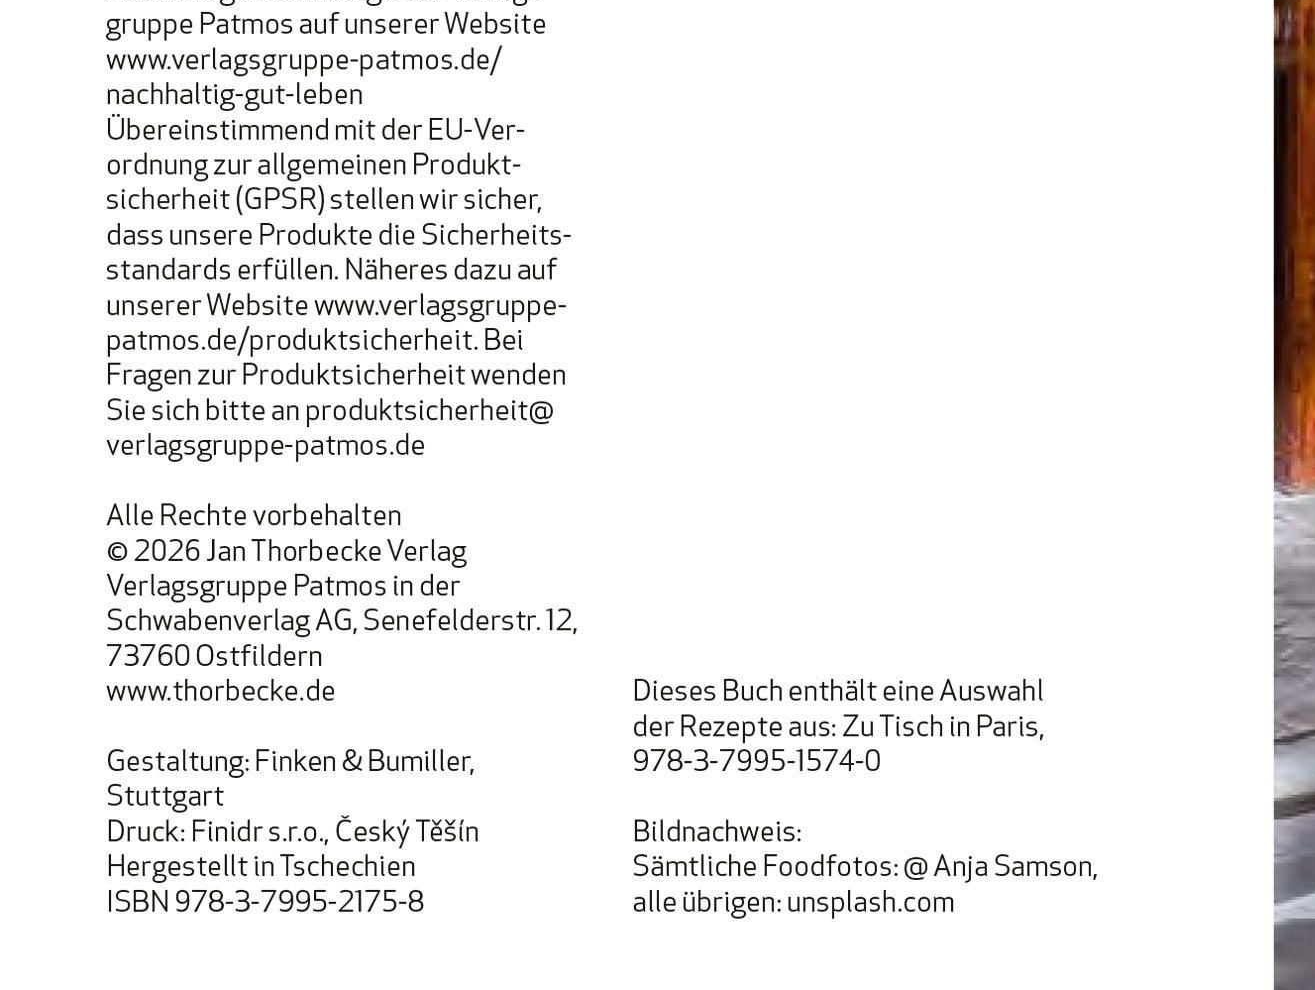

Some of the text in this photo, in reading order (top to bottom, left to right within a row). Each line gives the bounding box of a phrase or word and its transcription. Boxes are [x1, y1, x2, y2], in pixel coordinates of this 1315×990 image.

[106, 44, 503, 78] www.verlagsgruppe-patmos.de/
[107, 81, 363, 112] nachhaltig-gut-leben
[107, 113, 525, 141] Übereinstimmend mit der EU-Ver-
[107, 151, 522, 183] ordnung zur allgemeinen Produkt-
[106, 184, 542, 216] sicherheit (GPSR) stellen wir sicher,
[107, 292, 567, 323] unserer Website www.verlagsgruppe-
[107, 325, 523, 358] patmos.de/produktsicherheit. Bei
[107, 362, 566, 393] Fragen zur Produktsicherheit wenden
[107, 397, 554, 428] Sie sich bitte an produktsicherheit@
[106, 432, 425, 463] verlagsgruppe-patmos.de
[106, 502, 401, 526] Alle Rechte vorbehalten
[107, 538, 468, 569] © 2026 Jan Thorbecke Verlag
[106, 573, 461, 604] Verlagsgruppe Patmos in der
[107, 607, 578, 638] Schwabenverlag AG, Senefelderstr. 12,
[106, 643, 322, 667] 73760 Ostfildern
[105, 678, 335, 702] www.thorbecke.de
[634, 678, 1044, 702] Dieses Buch enthält eine Auswahl
[633, 713, 1044, 744] der Rezepte aus: Zu Tisch in Paris,
[107, 748, 475, 779] Gestaltung: Finken & Bumiller,
[633, 748, 881, 772] 978-3-7995-1574-0
[107, 783, 225, 814] Stuttgart
[108, 814, 479, 849] Druck: Finidr s.r.o., Český Těšín
[634, 818, 802, 843] Bildnachweis:
[108, 853, 416, 884] Hergestellt in Tschechien
[633, 853, 1098, 884] Sämtliche Foodfotos: @ Anja Samson,
[108, 889, 425, 913] ISBN 978-3-7995-2175-8
[633, 889, 954, 920] alle übrigen: unsplash.com
